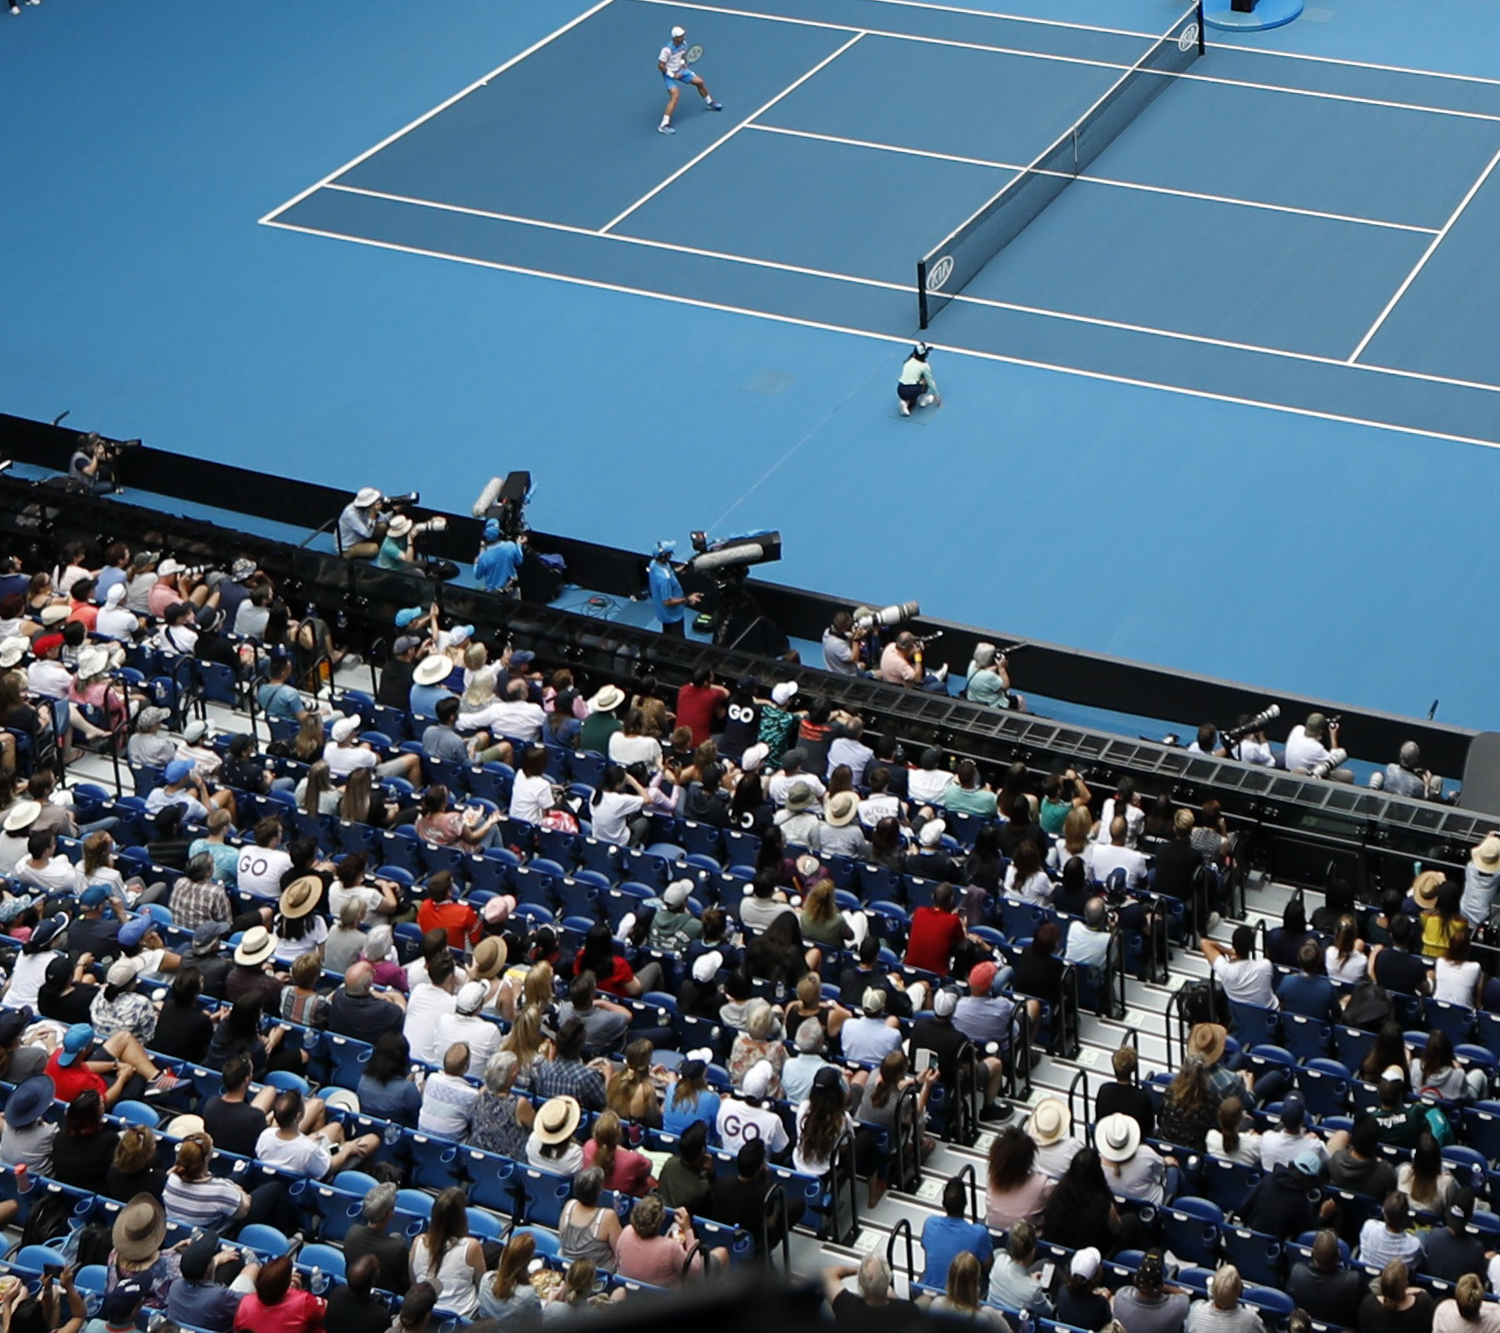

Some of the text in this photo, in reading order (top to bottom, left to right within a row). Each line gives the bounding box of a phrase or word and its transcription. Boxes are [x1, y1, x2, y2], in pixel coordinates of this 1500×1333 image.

[728, 703, 754, 724] GO
[239, 855, 268, 877] GO
[723, 1115, 761, 1144] GO
